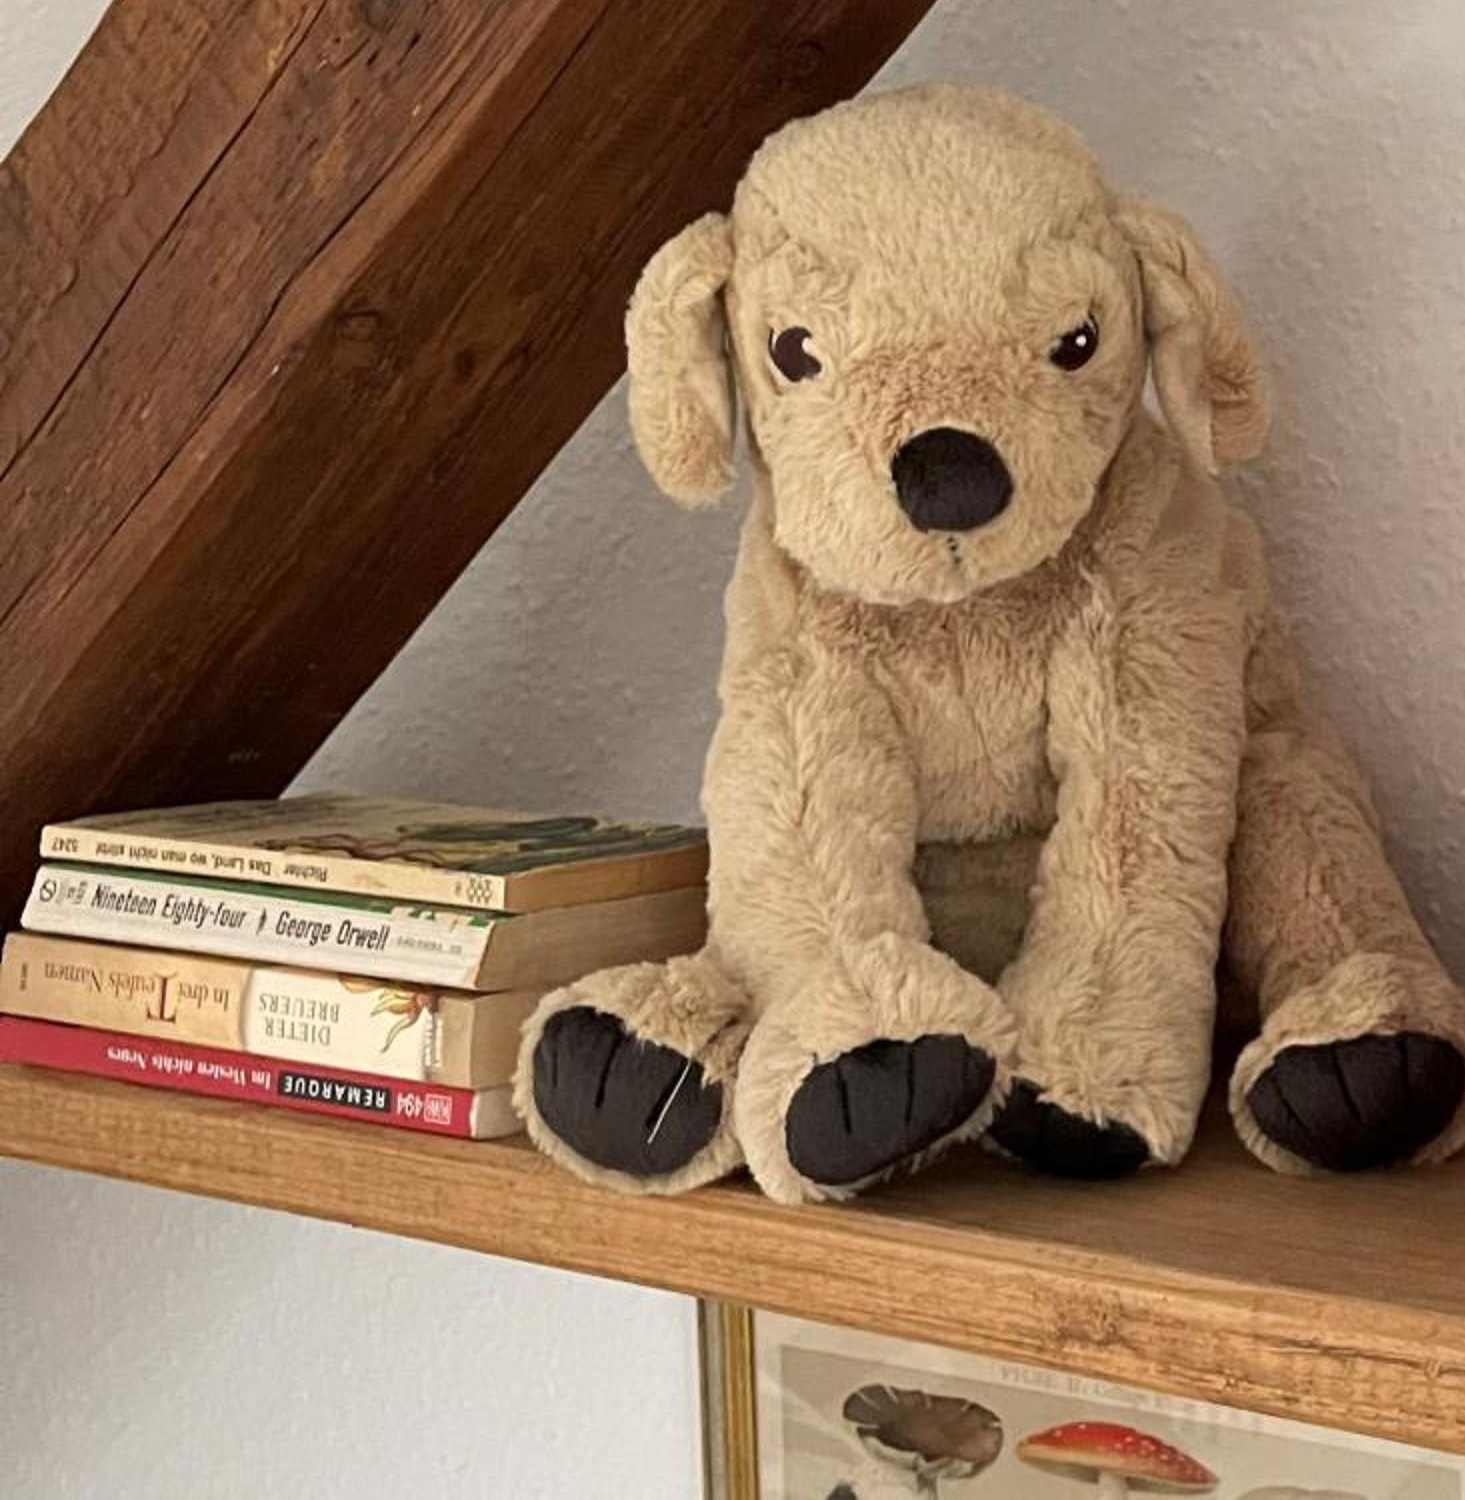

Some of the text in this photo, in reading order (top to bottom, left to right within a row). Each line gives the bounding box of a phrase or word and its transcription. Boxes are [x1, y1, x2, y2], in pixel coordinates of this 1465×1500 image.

[129, 845, 158, 860] nicht
[160, 850, 187, 863] man
[189, 852, 208, 865] wo
[211, 852, 244, 872] Land,
[248, 858, 272, 875] Das
[283, 865, 328, 883] Richter
[91, 883, 157, 917] Nineteen
[161, 893, 248, 929] Eighty-four
[275, 910, 332, 947] George
[336, 919, 391, 951] Orwell
[44, 962, 102, 993] Namen
[108, 970, 178, 1024] Teufels
[178, 980, 210, 1010] drei
[213, 988, 230, 1011] In
[258, 992, 341, 1024] BREUERS
[264, 1017, 332, 1047] DIETER
[107, 1045, 147, 1070] Neues
[151, 1054, 194, 1075] nichts
[196, 1061, 246, 1088] Westen
[251, 1070, 271, 1090] Im
[283, 1075, 388, 1109] REMARQUE
[396, 1092, 424, 1117] 494
